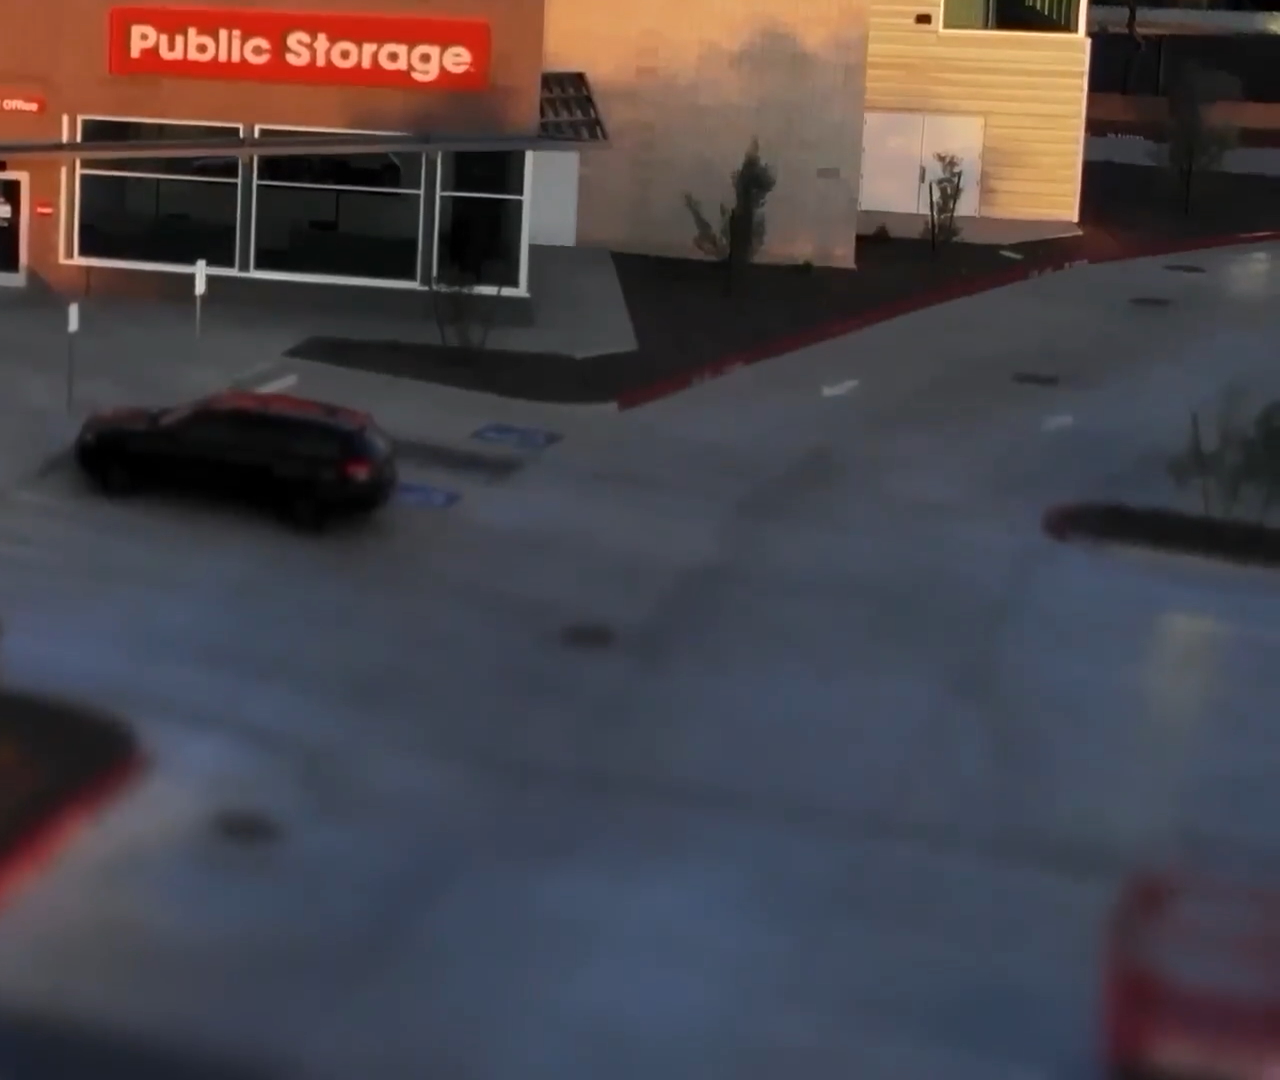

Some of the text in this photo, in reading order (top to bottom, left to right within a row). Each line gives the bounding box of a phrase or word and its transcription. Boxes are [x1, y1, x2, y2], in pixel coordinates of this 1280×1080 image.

[130, 24, 473, 83] Public Storage
[2, 99, 38, 112] Office
